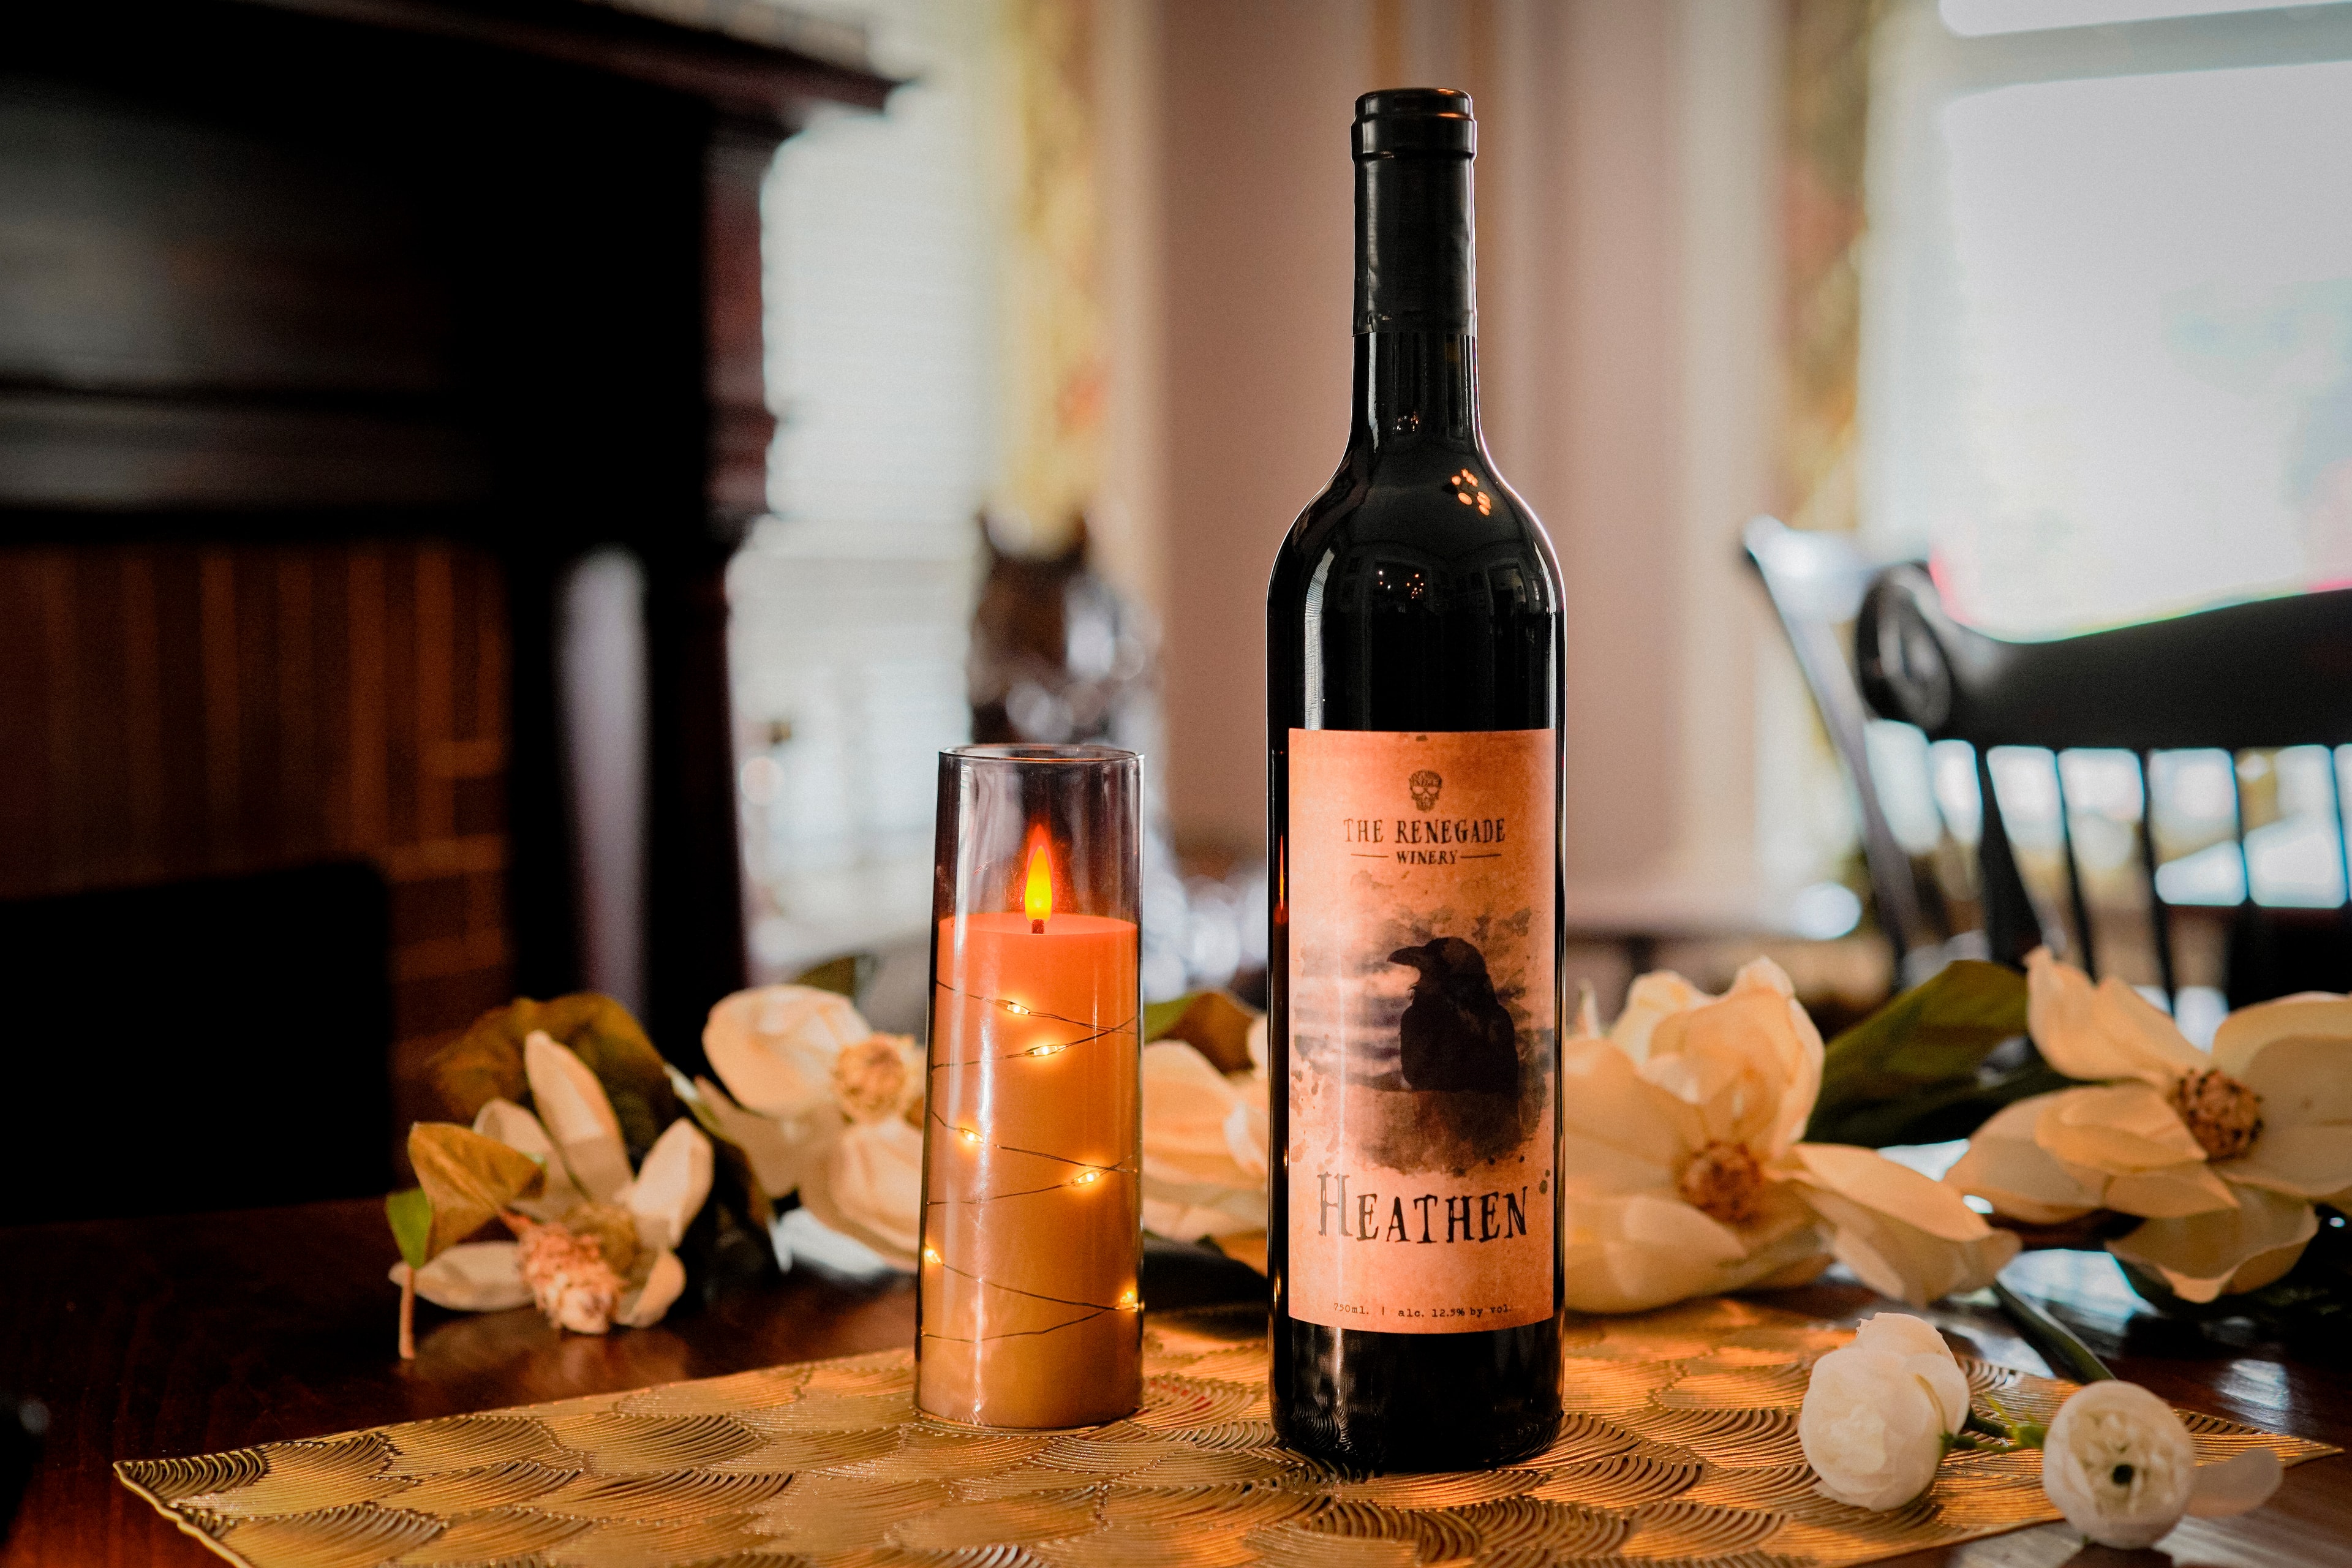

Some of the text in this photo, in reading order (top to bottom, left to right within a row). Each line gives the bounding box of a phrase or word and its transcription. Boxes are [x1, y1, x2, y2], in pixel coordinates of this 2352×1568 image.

[1343, 818, 1506, 844] THE RENEGADE
[1396, 850, 1459, 865] WINERY
[1317, 1170, 1529, 1244] HEATHEN
[1333, 1303, 1370, 1314] 750ml.
[1398, 1308, 1424, 1317] alc.
[1431, 1307, 1466, 1317] 12.5%
[1470, 1306, 1483, 1318] by
[1490, 1303, 1512, 1314] vol.
